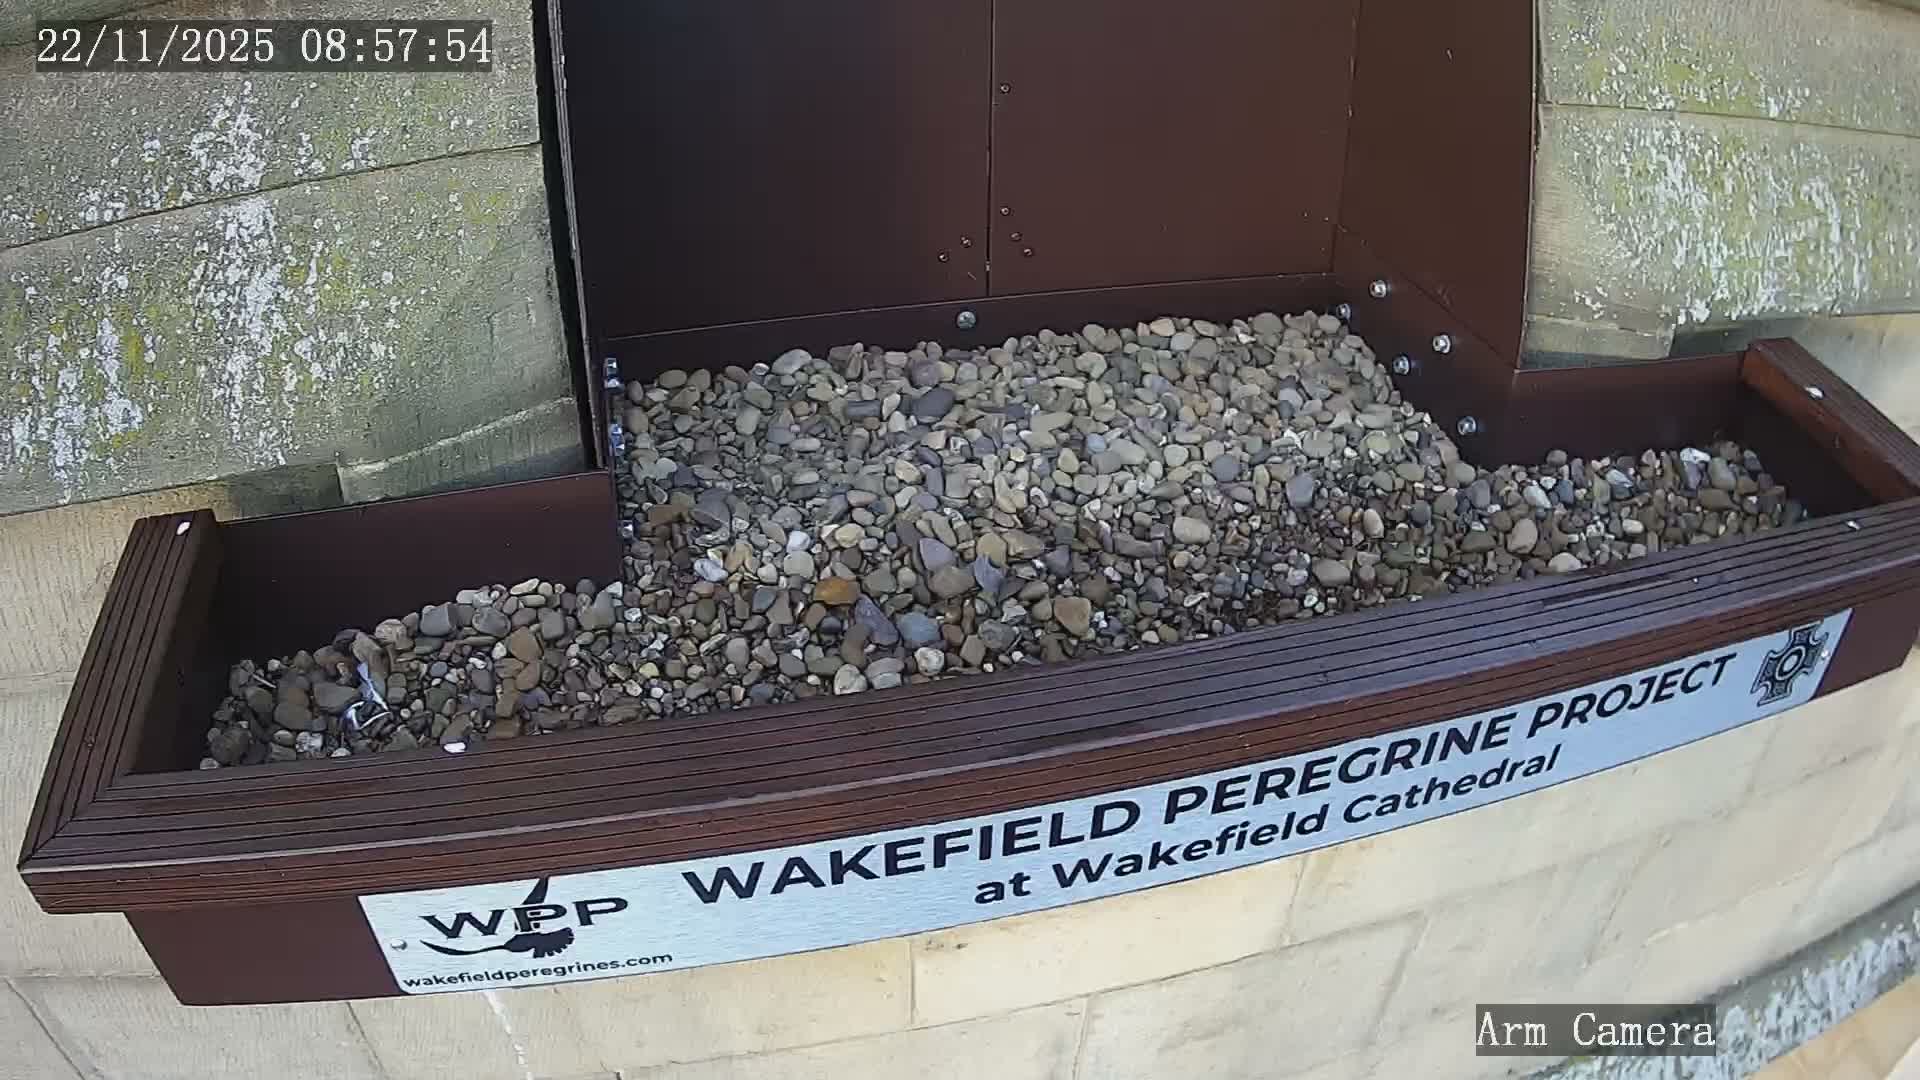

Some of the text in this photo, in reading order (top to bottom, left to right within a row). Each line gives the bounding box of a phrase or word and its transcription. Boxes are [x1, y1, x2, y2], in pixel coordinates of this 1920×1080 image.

[681, 652, 1737, 904] WAKEFIELD PEREGRINE PROJECT
[974, 743, 1562, 904] at Wakefield Cathedral
[419, 896, 629, 940] WPP
[403, 952, 673, 988] wakefieldperegrines.com
